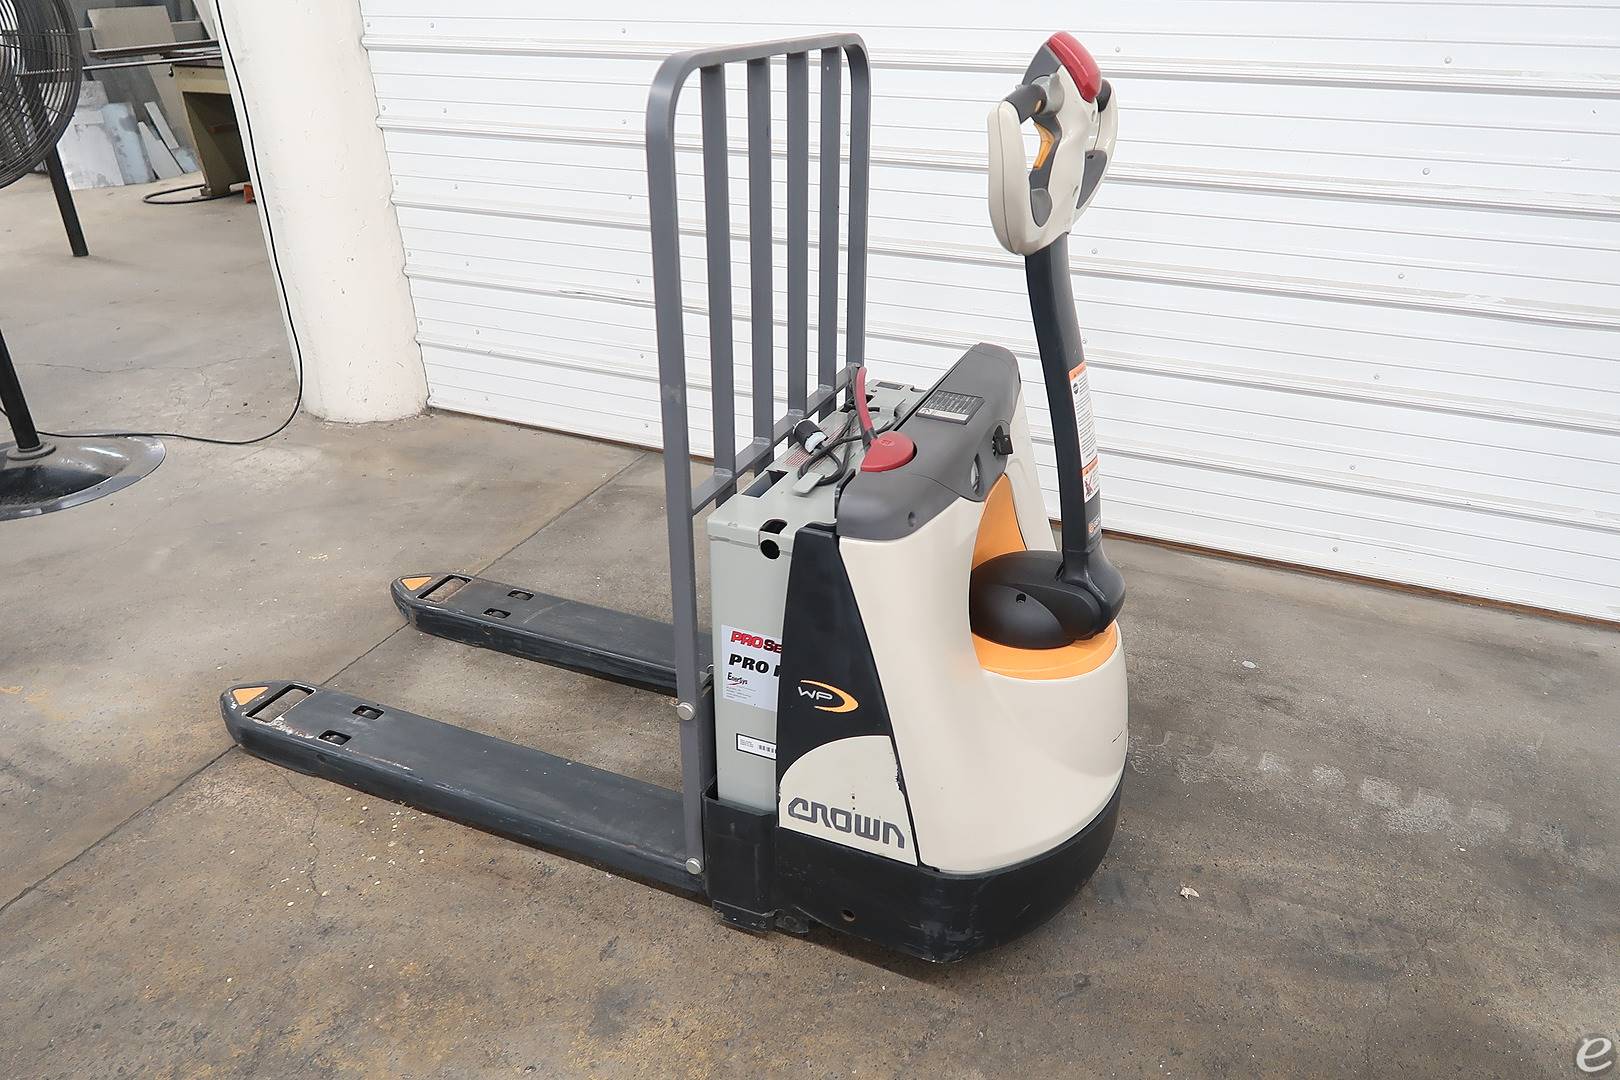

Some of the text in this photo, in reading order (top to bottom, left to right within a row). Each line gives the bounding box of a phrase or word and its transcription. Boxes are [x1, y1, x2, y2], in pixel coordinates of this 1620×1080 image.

[729, 653, 769, 674] PRO
[798, 686, 833, 700] WP
[788, 797, 905, 849] CROWN
